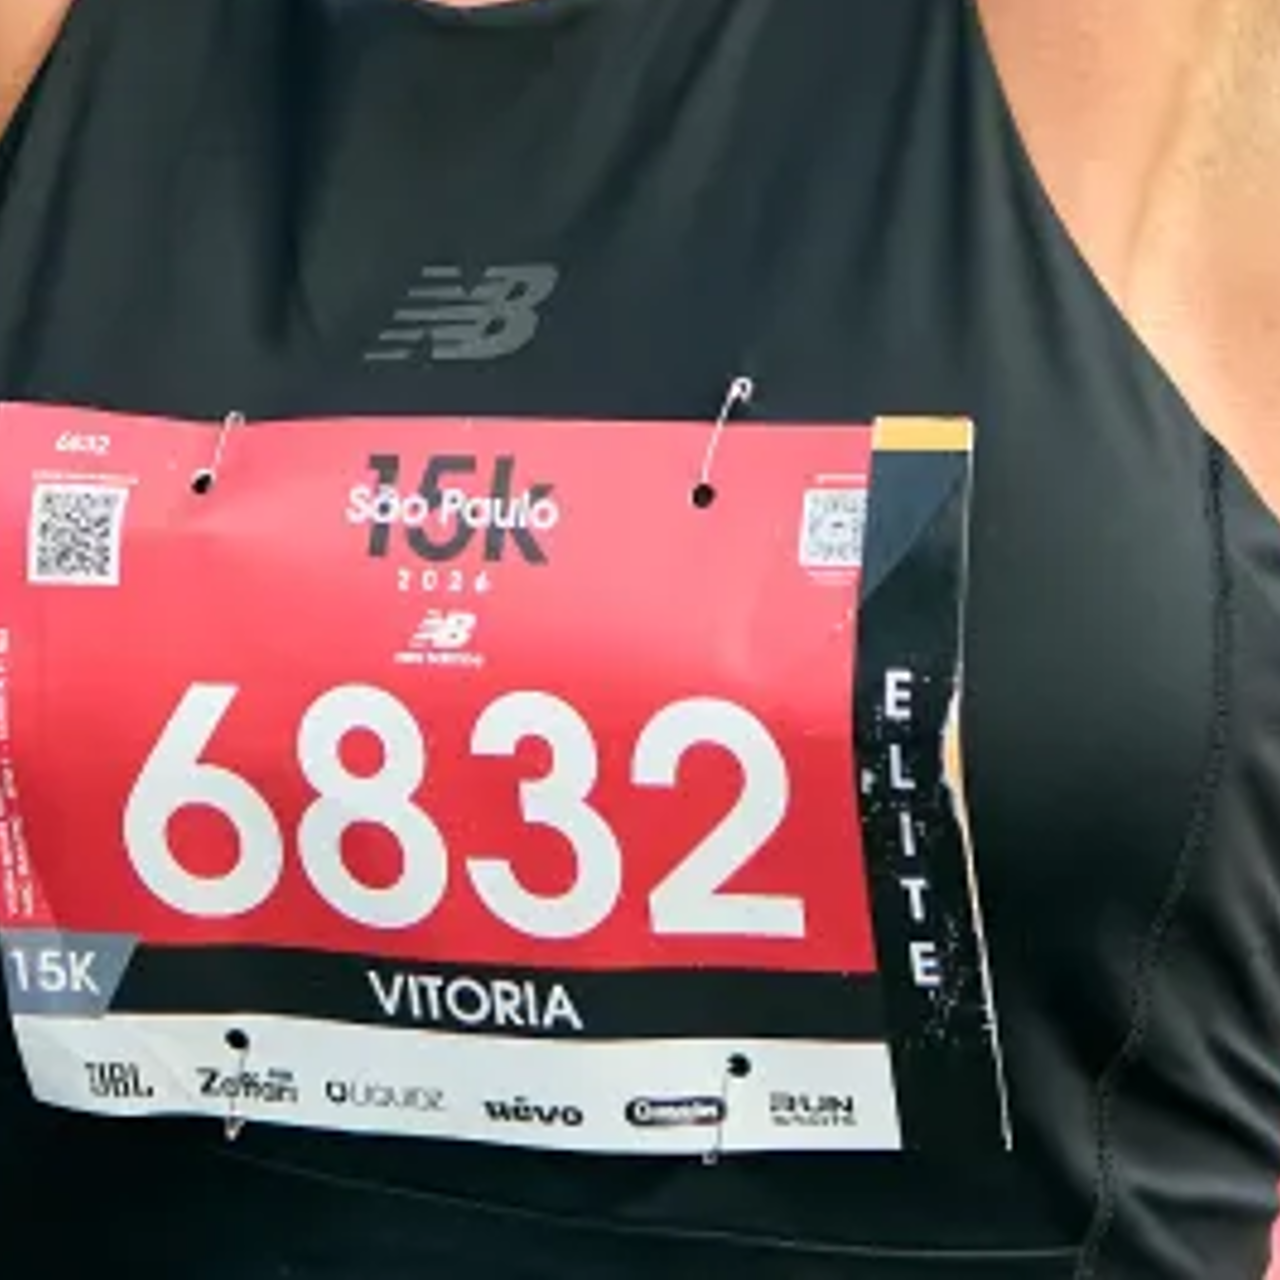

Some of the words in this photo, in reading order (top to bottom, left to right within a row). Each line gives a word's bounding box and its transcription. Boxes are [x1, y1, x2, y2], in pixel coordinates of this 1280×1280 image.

[438, 487, 560, 530] Paulo
[396, 568, 491, 594] 2026
[123, 683, 806, 938] 6832
[884, 666, 941, 987] ELITE
[10, 950, 101, 994] 15K
[367, 969, 584, 1031] VITORIA
